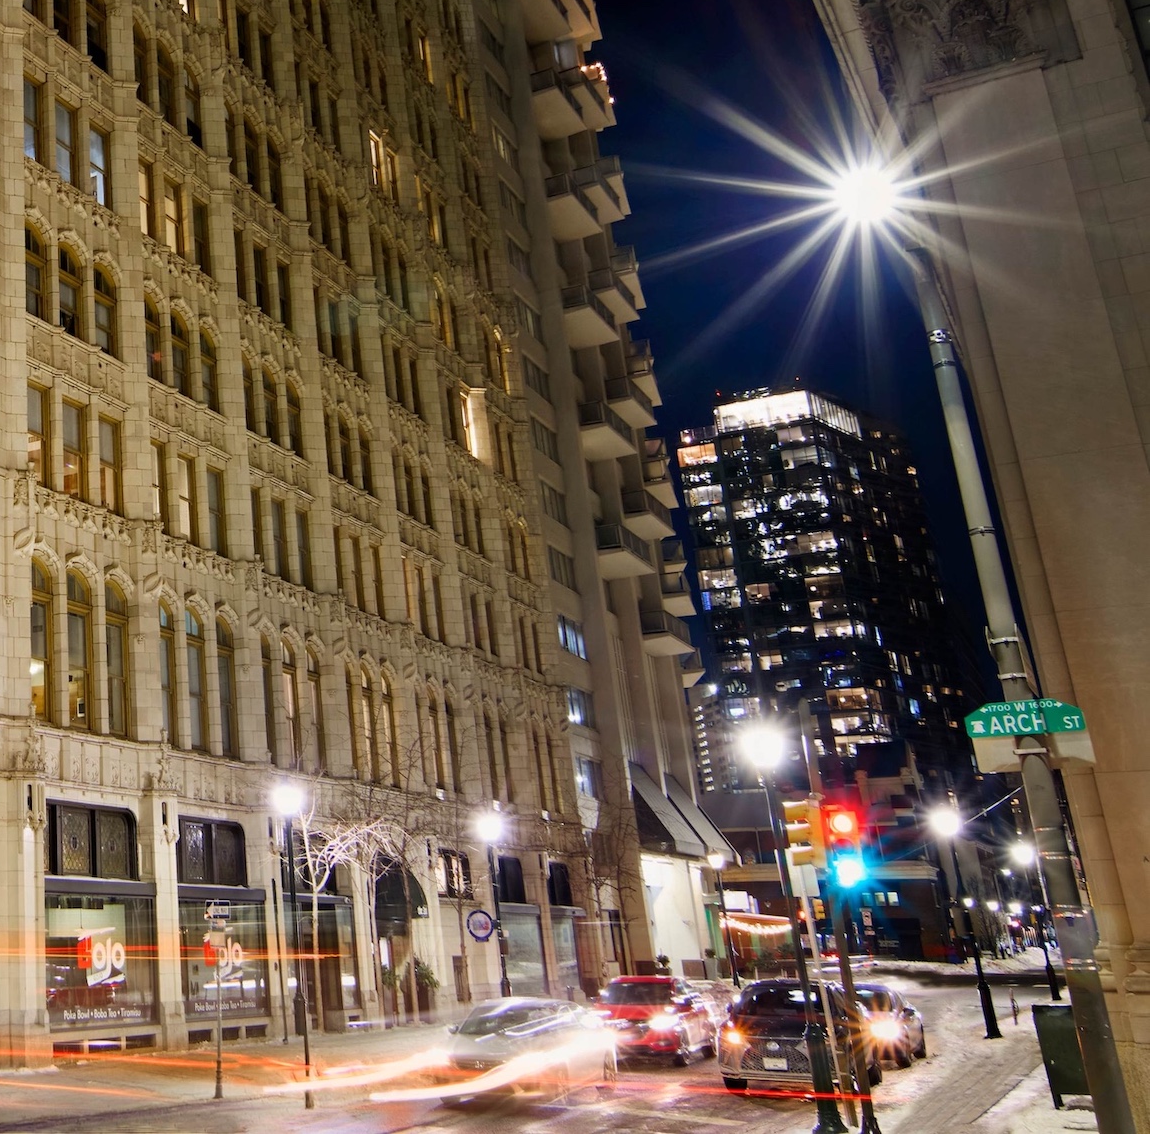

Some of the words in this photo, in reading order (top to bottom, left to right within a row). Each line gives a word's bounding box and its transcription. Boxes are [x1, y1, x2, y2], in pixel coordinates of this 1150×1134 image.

[987, 705, 1011, 713] 1700
[1013, 702, 1026, 712] W
[1028, 700, 1054, 709] 1600
[990, 713, 1048, 735] ARCH
[1062, 715, 1080, 729] ST
[63, 1009, 77, 1020] Poke
[77, 1008, 90, 1019] Bowl
[94, 1008, 107, 1019] Boba
[107, 1008, 117, 1018] Tea
[120, 1007, 141, 1017] Tiramisu
